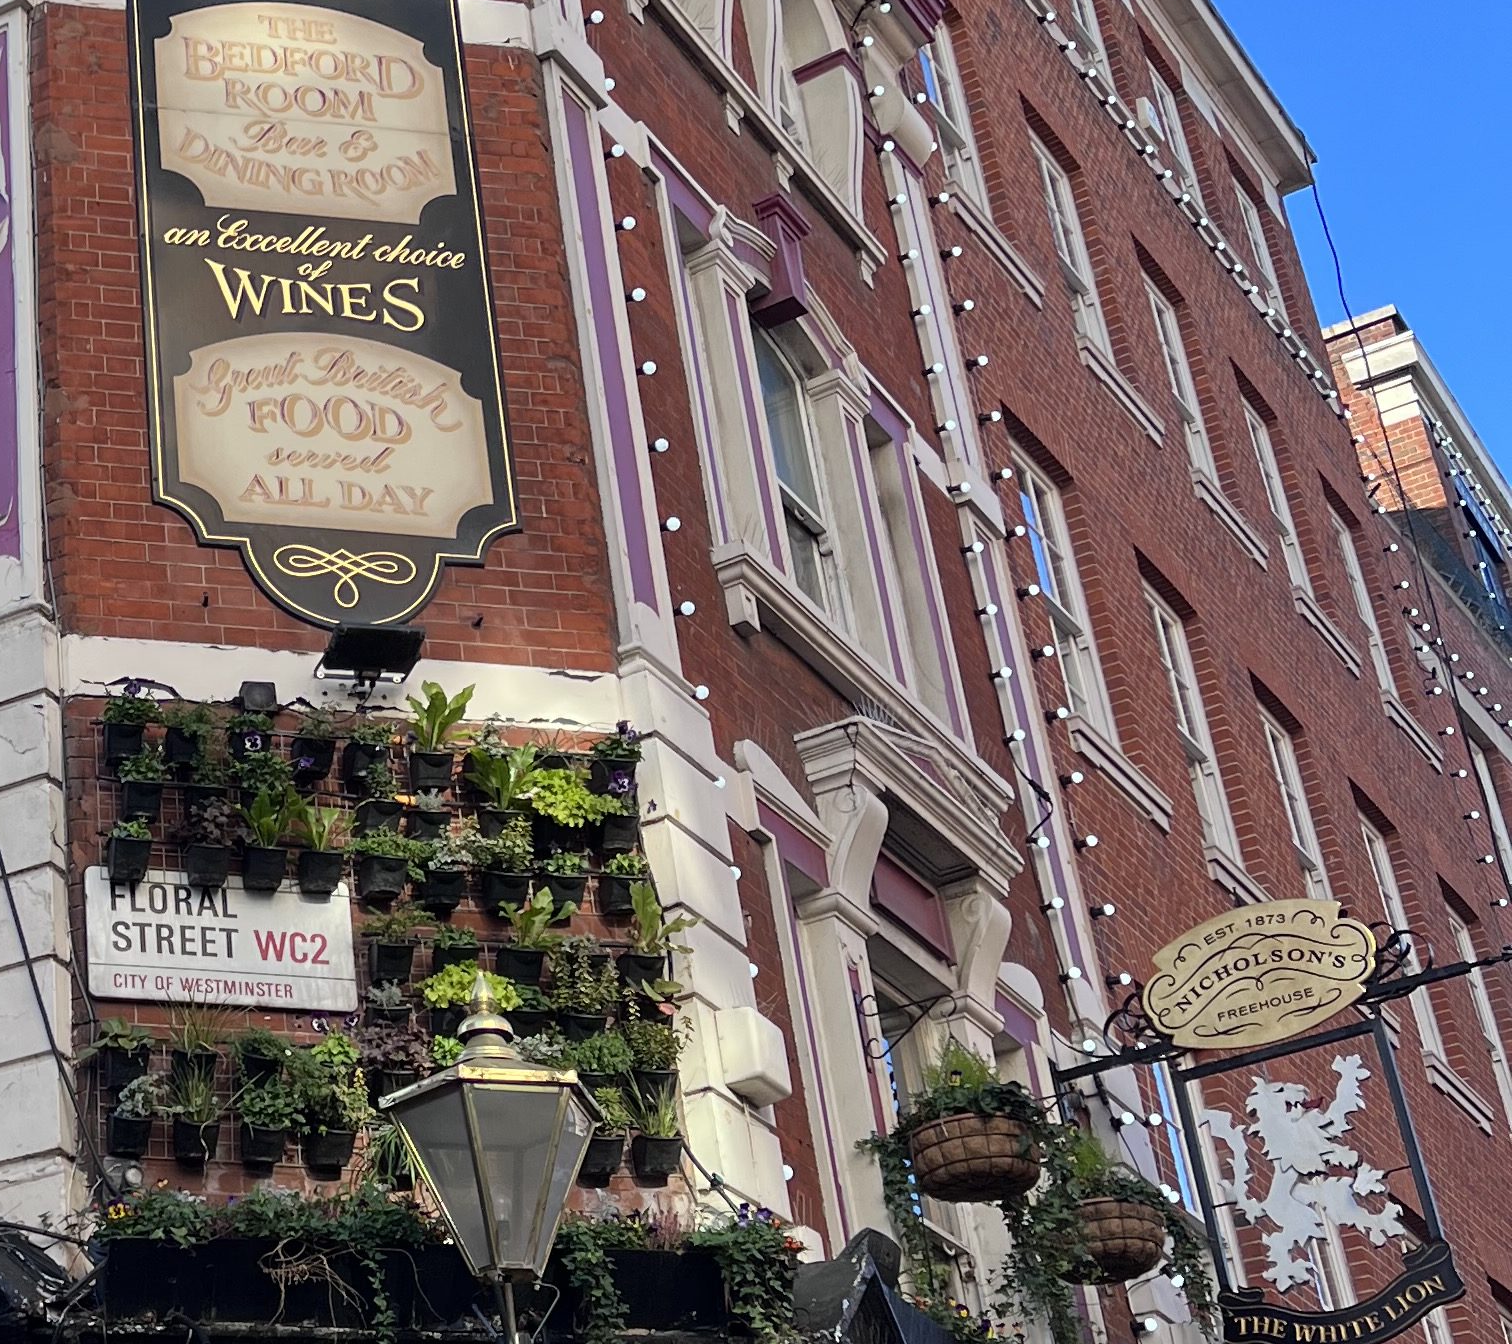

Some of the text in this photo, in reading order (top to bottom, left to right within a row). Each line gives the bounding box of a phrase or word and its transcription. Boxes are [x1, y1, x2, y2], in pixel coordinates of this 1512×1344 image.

[257, 14, 337, 44] THE
[181, 36, 425, 100] BEDFORD
[223, 77, 378, 123] ROOM
[229, 119, 380, 163] Bar &
[178, 126, 441, 207] DINING ROOM
[164, 213, 467, 271] an Excellent choice
[297, 260, 328, 282] of
[203, 257, 426, 332] WINES
[191, 346, 465, 434] Great British
[247, 393, 413, 445] FOOD
[265, 446, 396, 474] served
[238, 473, 436, 518] ALL DAY
[109, 882, 238, 919] FLORAL
[1245, 913, 1287, 929] 1873
[111, 920, 331, 966] STREET WC2
[113, 972, 294, 1000] CITY OF WESTMINSTER
[1173, 947, 1347, 1015] NICHOLSON'S
[1217, 986, 1315, 1023] FREEHOUSE
[1234, 1274, 1447, 1344] THE WHITE LION
